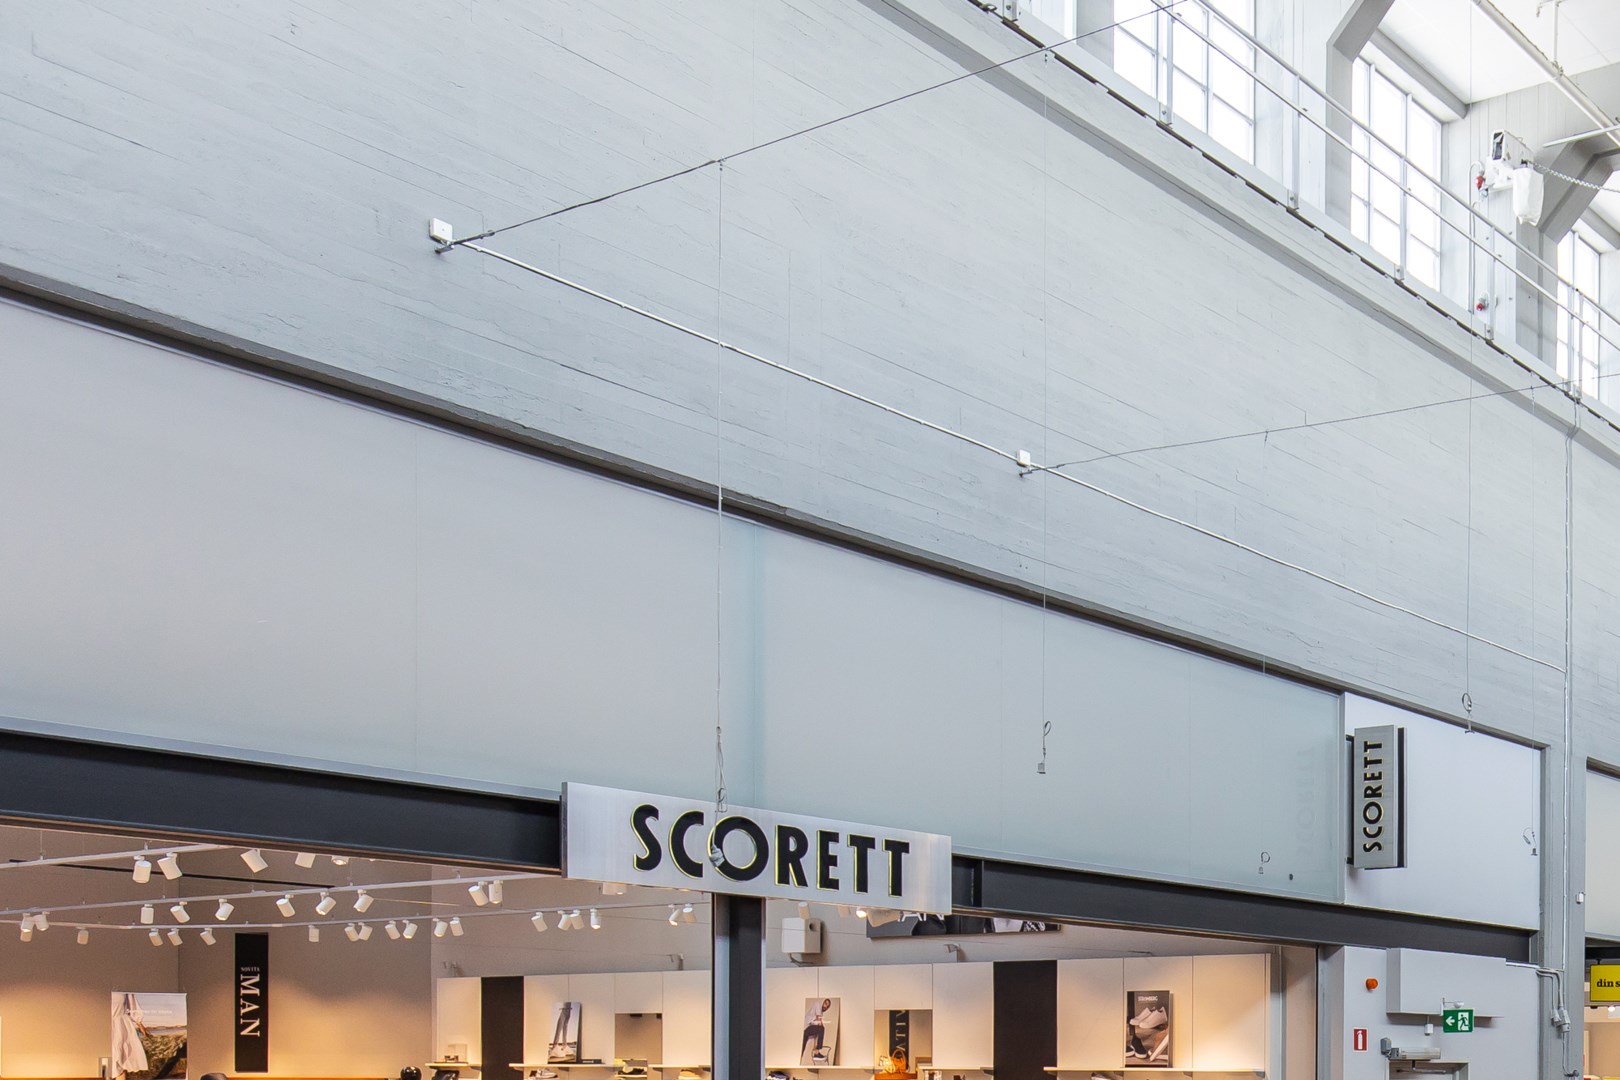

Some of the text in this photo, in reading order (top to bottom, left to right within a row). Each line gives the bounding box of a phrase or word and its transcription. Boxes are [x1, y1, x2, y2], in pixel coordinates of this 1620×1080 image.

[1363, 741, 1384, 853] SCORETT
[631, 803, 912, 898] SCORETT
[240, 973, 260, 1037] MAN
[1596, 979, 1614, 988] din
